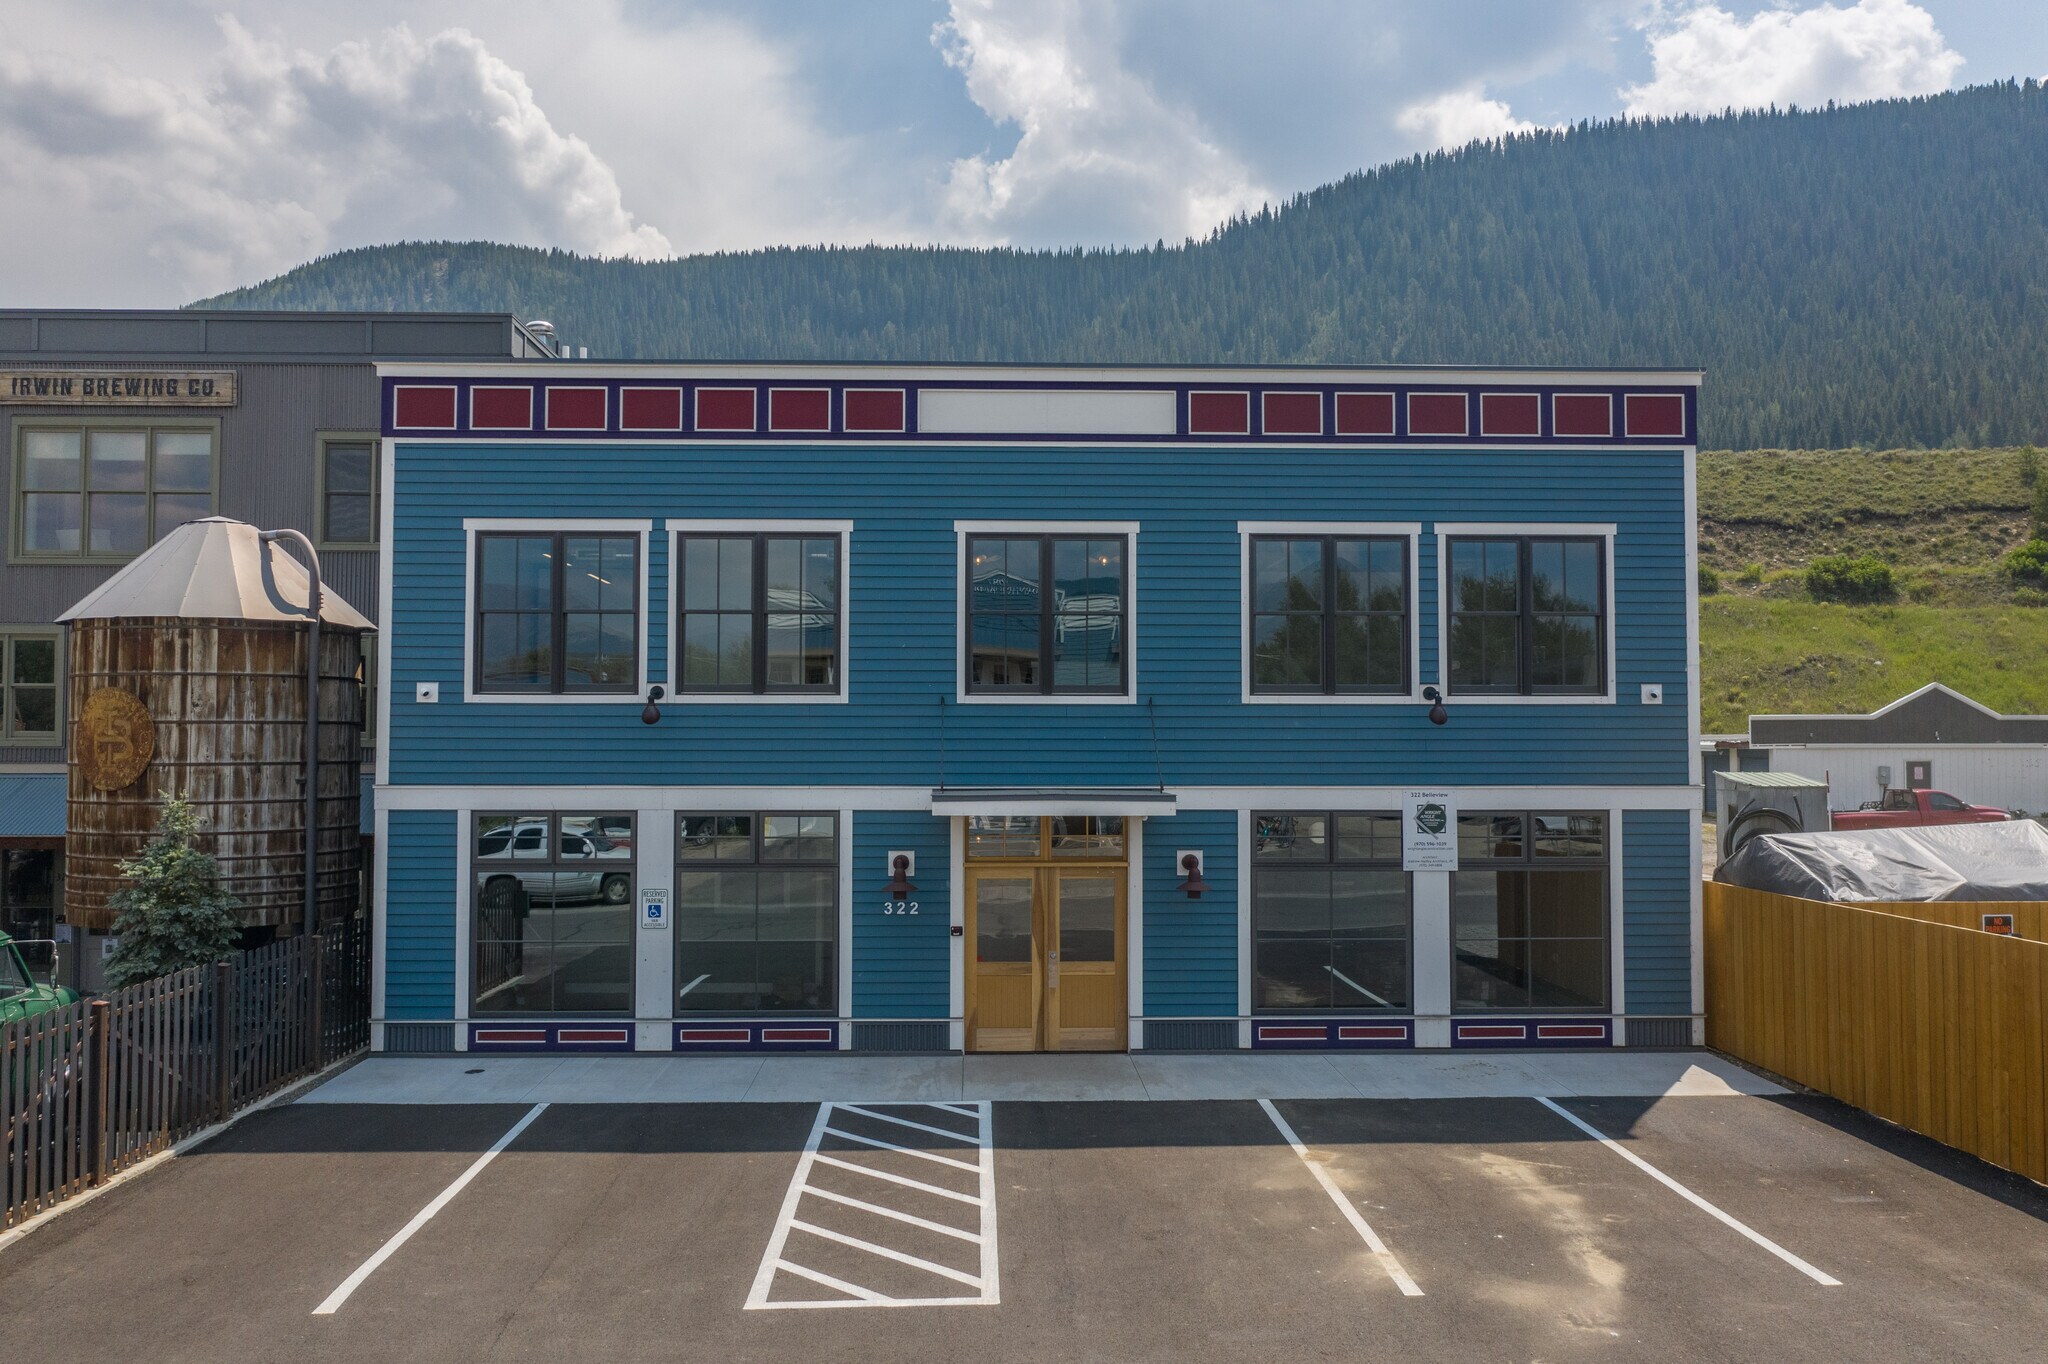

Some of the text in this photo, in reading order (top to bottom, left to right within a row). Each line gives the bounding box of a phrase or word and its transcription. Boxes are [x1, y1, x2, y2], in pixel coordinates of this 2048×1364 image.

[11, 377, 221, 397] IRWIN BREWING CO.
[883, 901, 919, 915] 322
